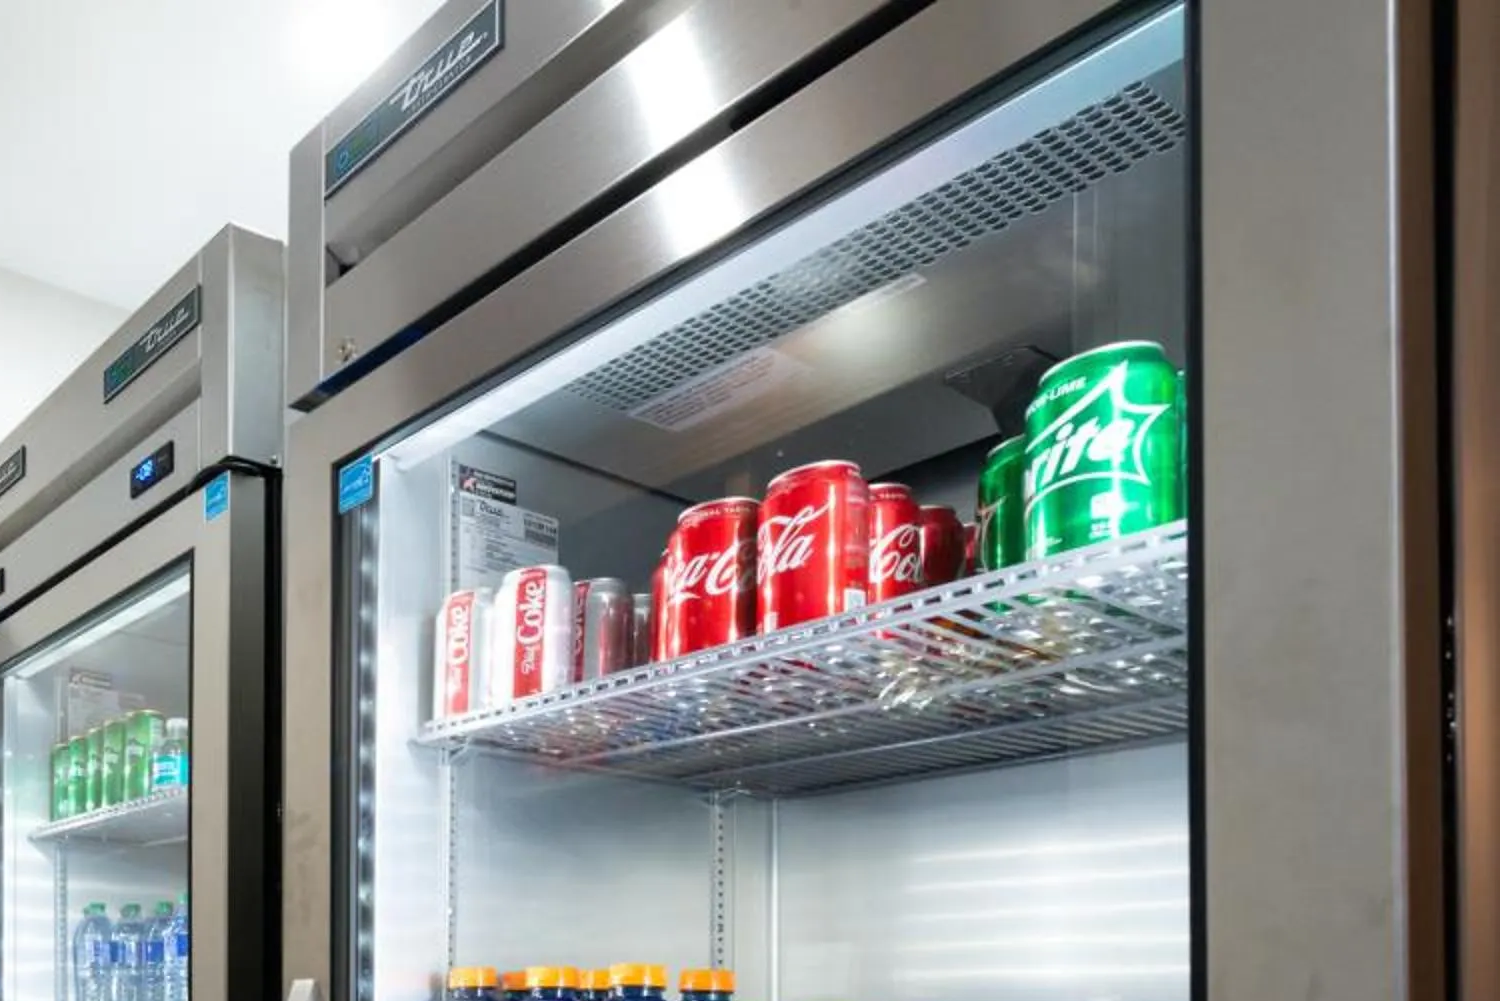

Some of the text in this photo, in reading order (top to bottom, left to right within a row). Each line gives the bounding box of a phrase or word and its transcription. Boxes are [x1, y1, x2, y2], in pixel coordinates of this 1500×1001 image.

[388, 31, 484, 112] True
[1024, 416, 1135, 494] rite
[517, 580, 545, 645] Coke
